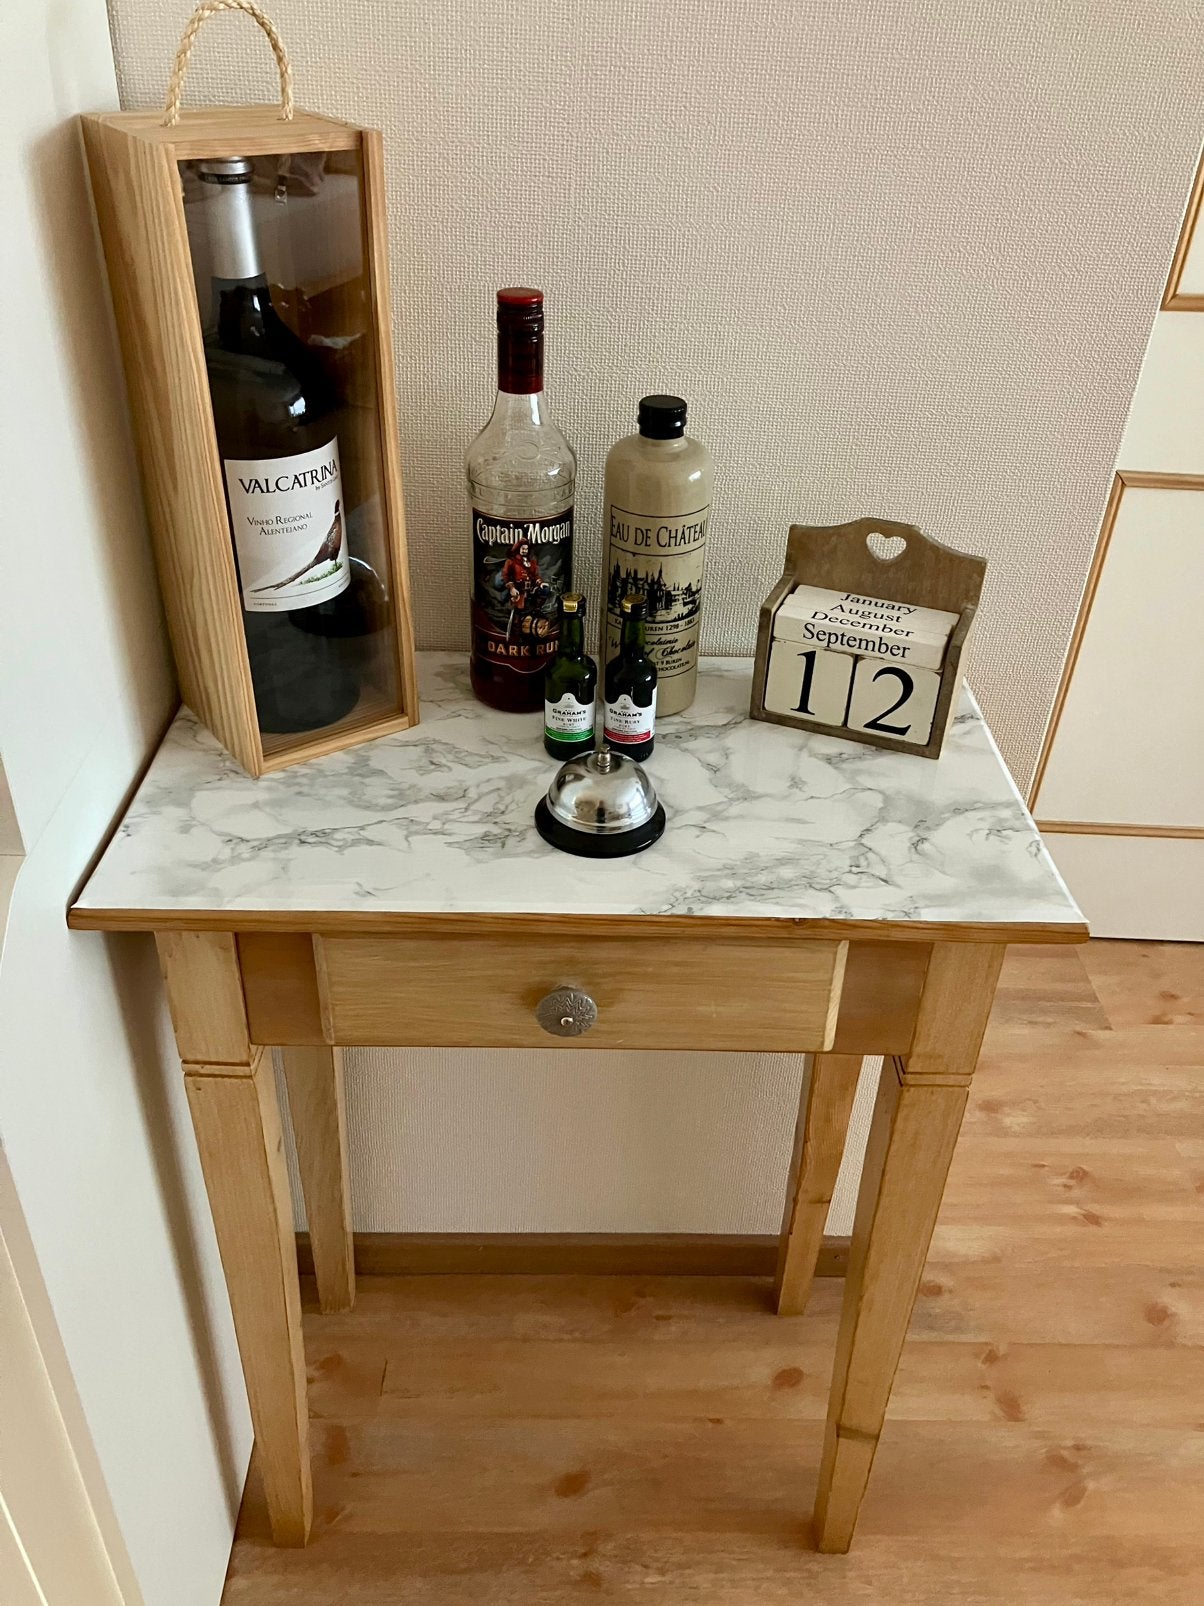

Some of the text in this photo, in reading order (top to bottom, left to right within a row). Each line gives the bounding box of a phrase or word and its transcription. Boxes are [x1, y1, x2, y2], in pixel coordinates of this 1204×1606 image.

[238, 459, 338, 494] VALCATRINA
[247, 512, 314, 526] VINHO REGIONAL
[259, 523, 308, 536] ALENTEJANO
[476, 518, 571, 546] Captain Morgan
[611, 514, 630, 542] EAU
[633, 527, 652, 547] DE
[830, 604, 904, 623] August
[840, 593, 918, 616] January
[810, 611, 915, 638] December
[487, 640, 530, 657] DARK
[802, 622, 911, 659] September
[552, 708, 587, 716] GRAHAM'S
[609, 708, 643, 717] GRAHAM'S
